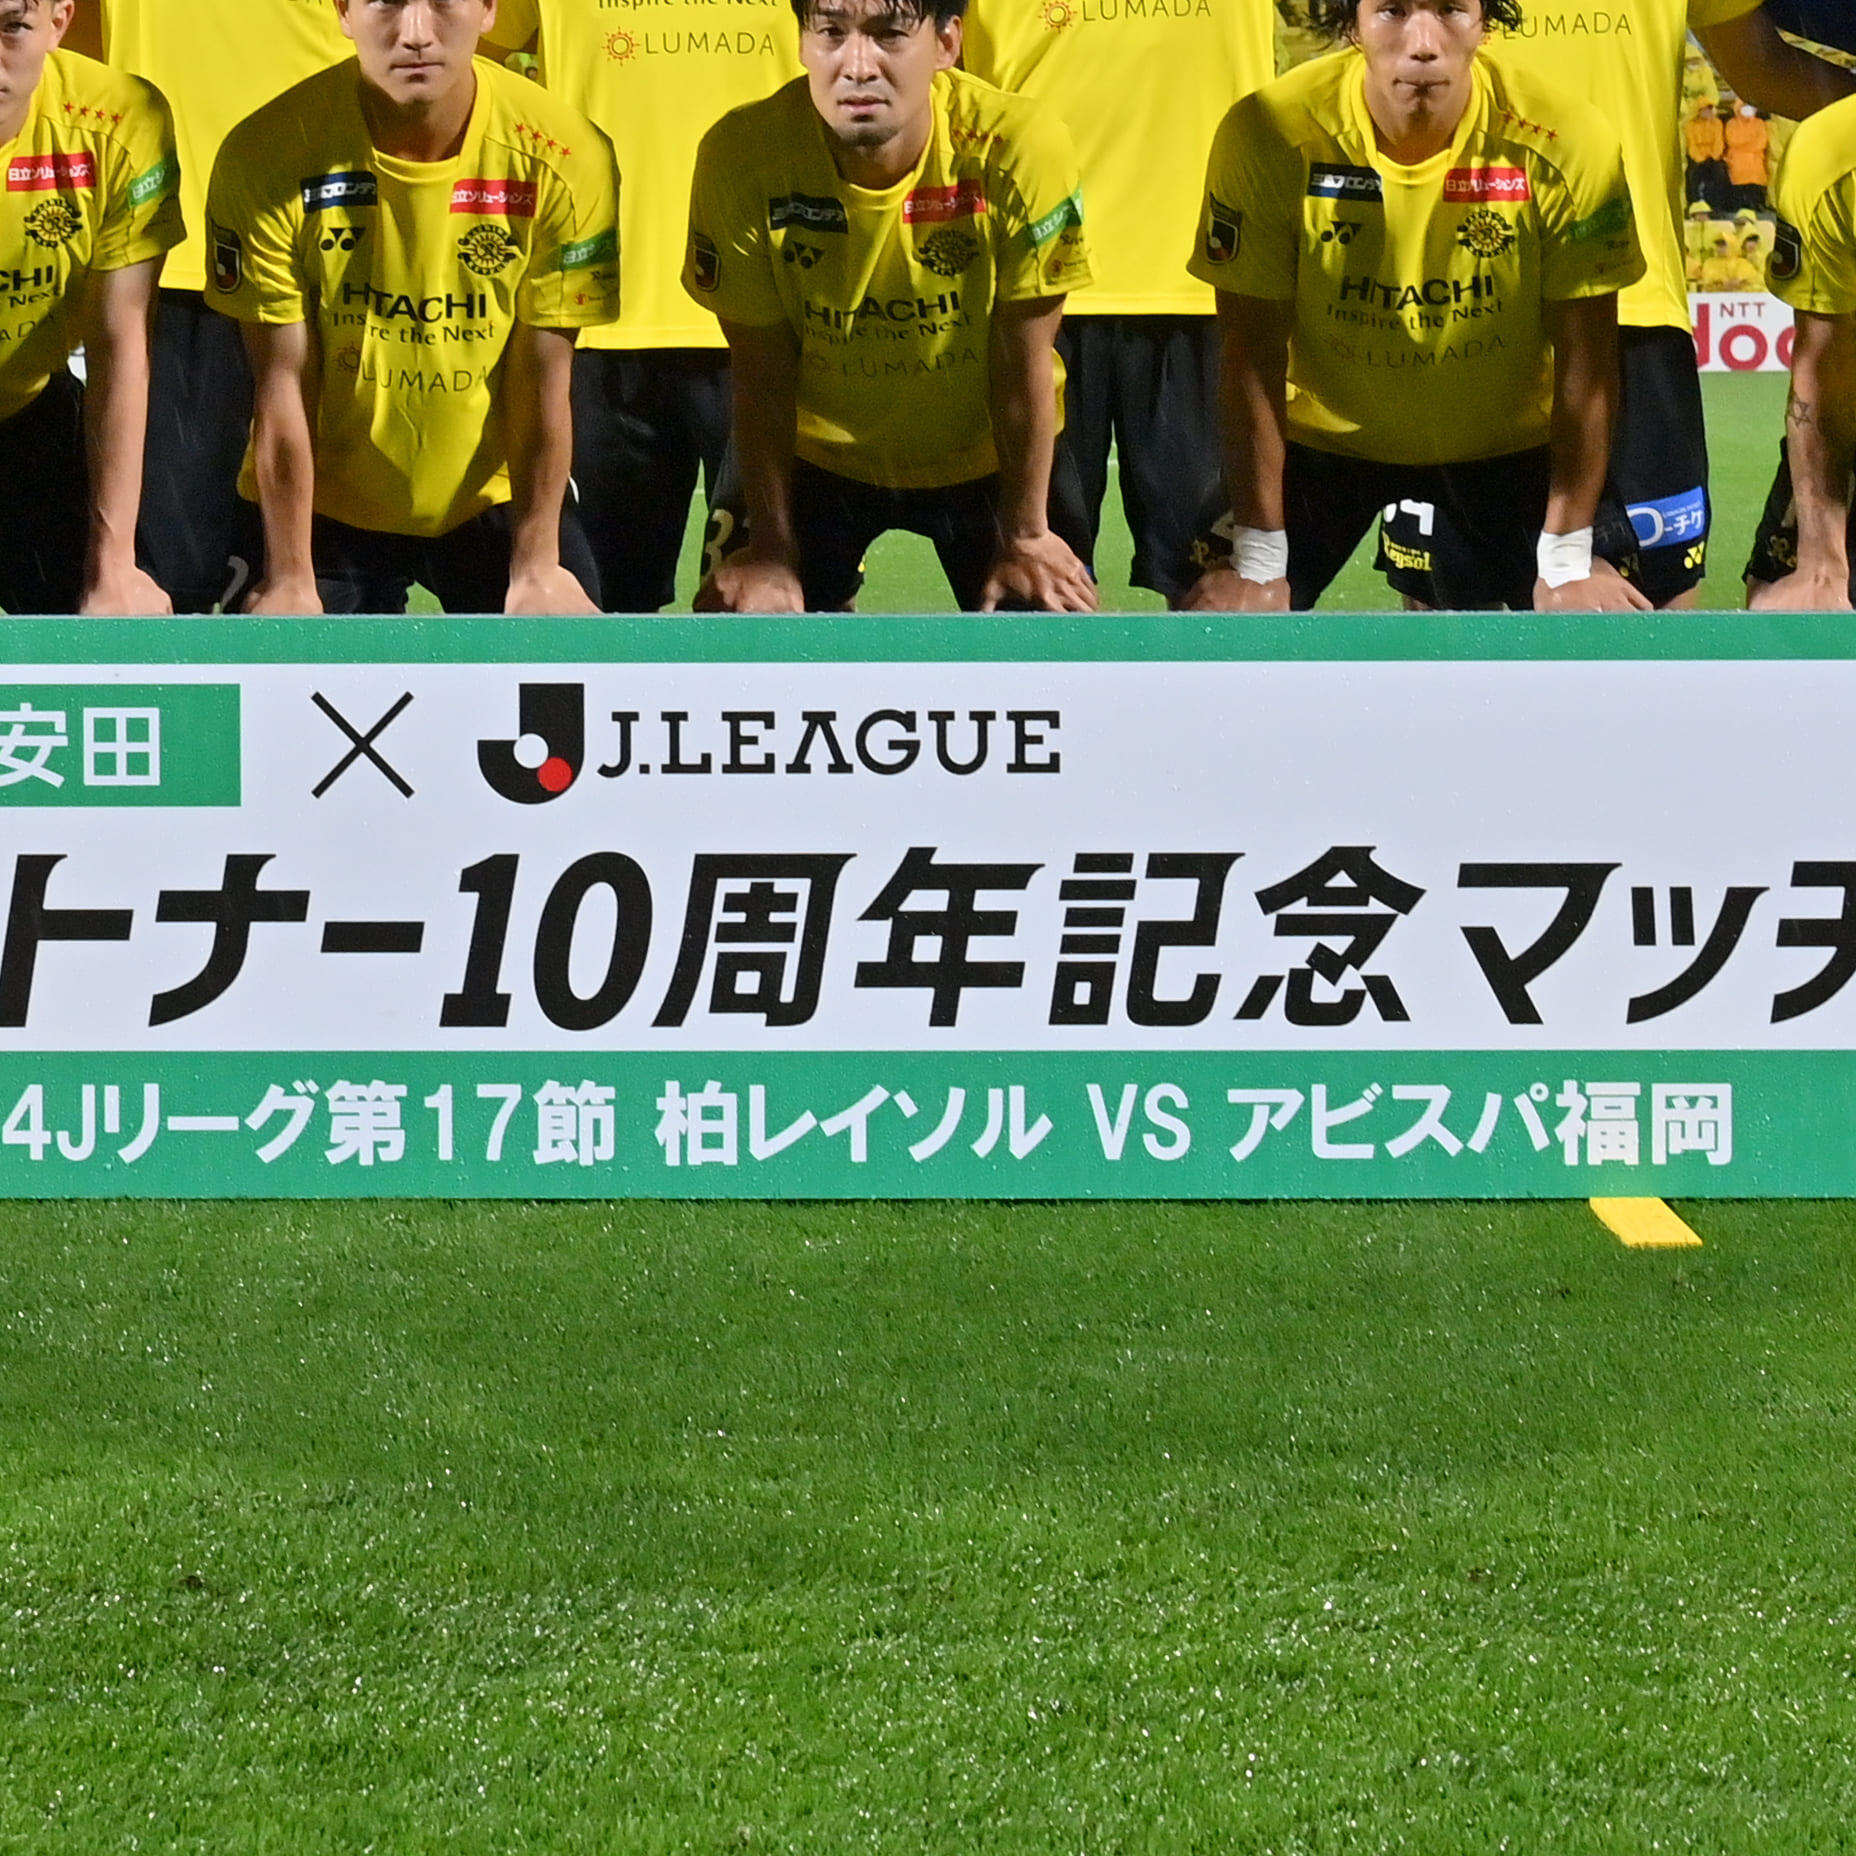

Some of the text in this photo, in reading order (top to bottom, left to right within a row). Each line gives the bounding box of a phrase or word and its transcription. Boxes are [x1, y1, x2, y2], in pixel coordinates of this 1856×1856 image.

[645, 31, 776, 56] LUMADA
[1340, 274, 1494, 312] HITACHI
[1409, 311, 1444, 331] the
[1452, 299, 1503, 324] Next
[1719, 301, 1766, 319] NTT
[399, 324, 436, 346] the
[443, 320, 495, 342] Next
[1366, 335, 1506, 370] LUMADA
[597, 708, 1063, 777] J.LEAGUE
[655, 1079, 1052, 1166] 柏レイソル
[1086, 1081, 1191, 1162] VS
[1227, 1079, 1735, 1168] アビスパ福岡
